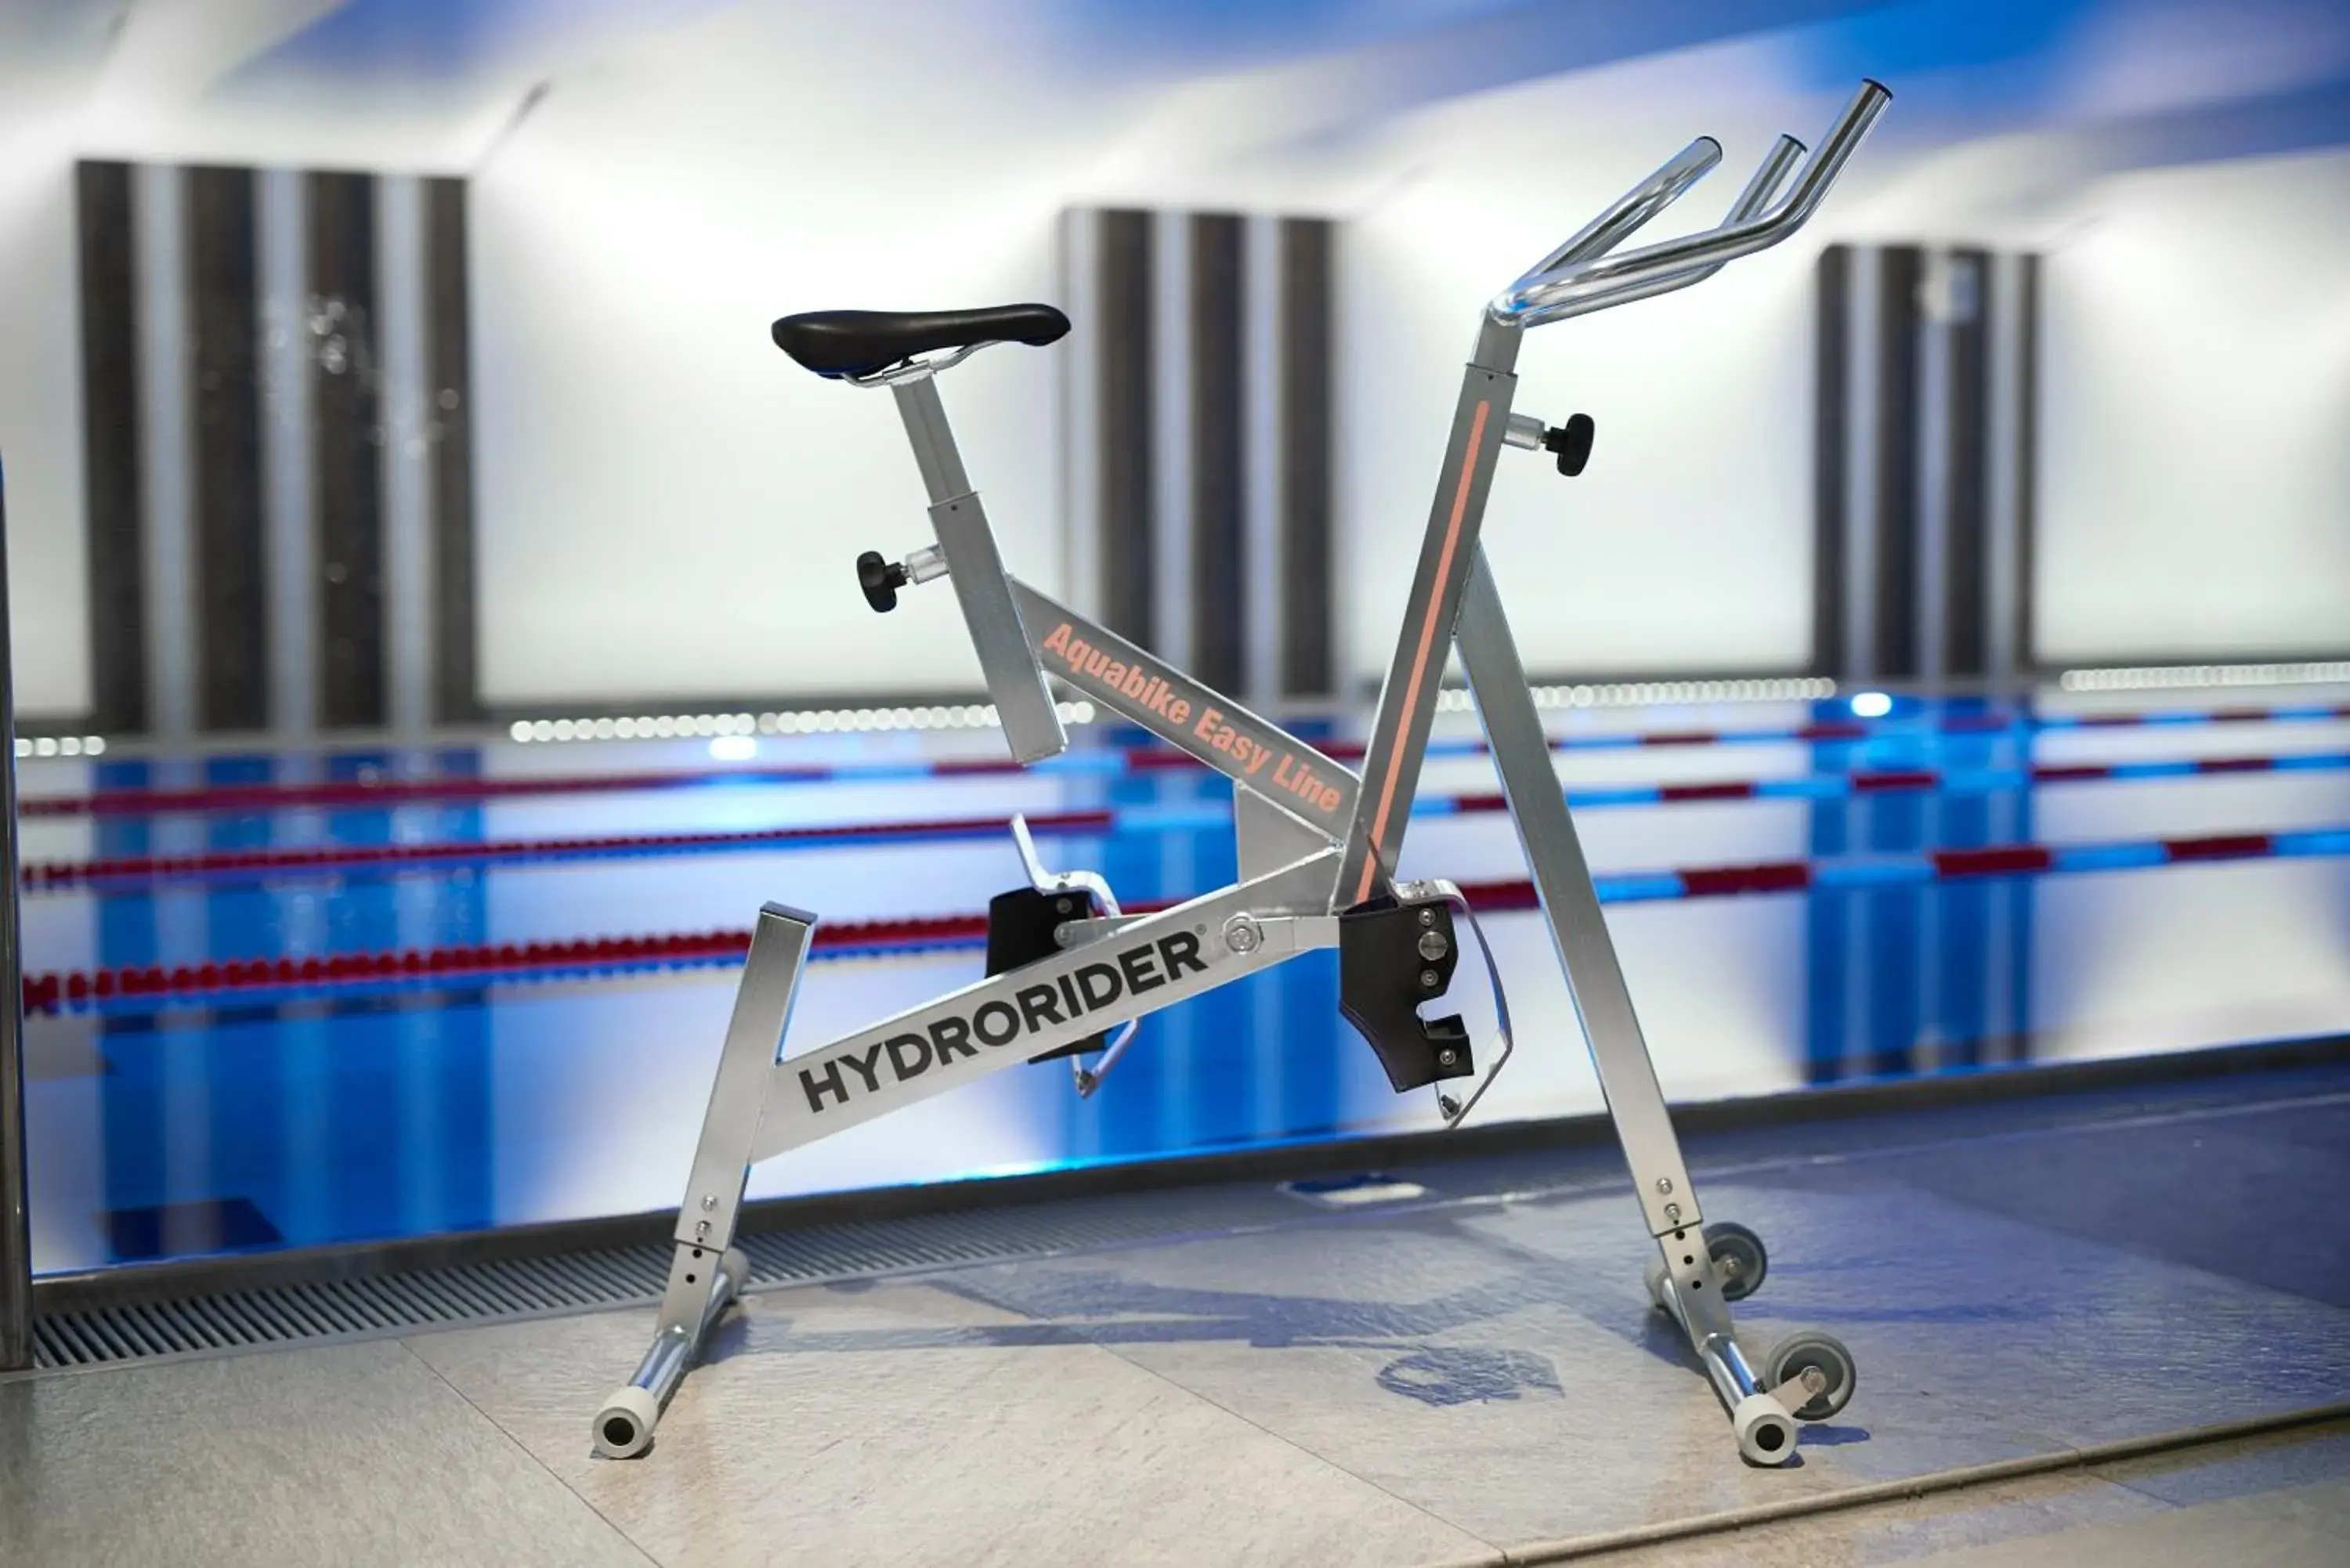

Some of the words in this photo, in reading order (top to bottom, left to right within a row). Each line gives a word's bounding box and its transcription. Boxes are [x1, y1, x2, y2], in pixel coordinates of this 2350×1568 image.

[1043, 623, 1191, 724] Aquabike
[1193, 707, 1273, 775] Easy
[1273, 754, 1341, 811] Line
[798, 930, 1209, 1113] HYDRORIDER
